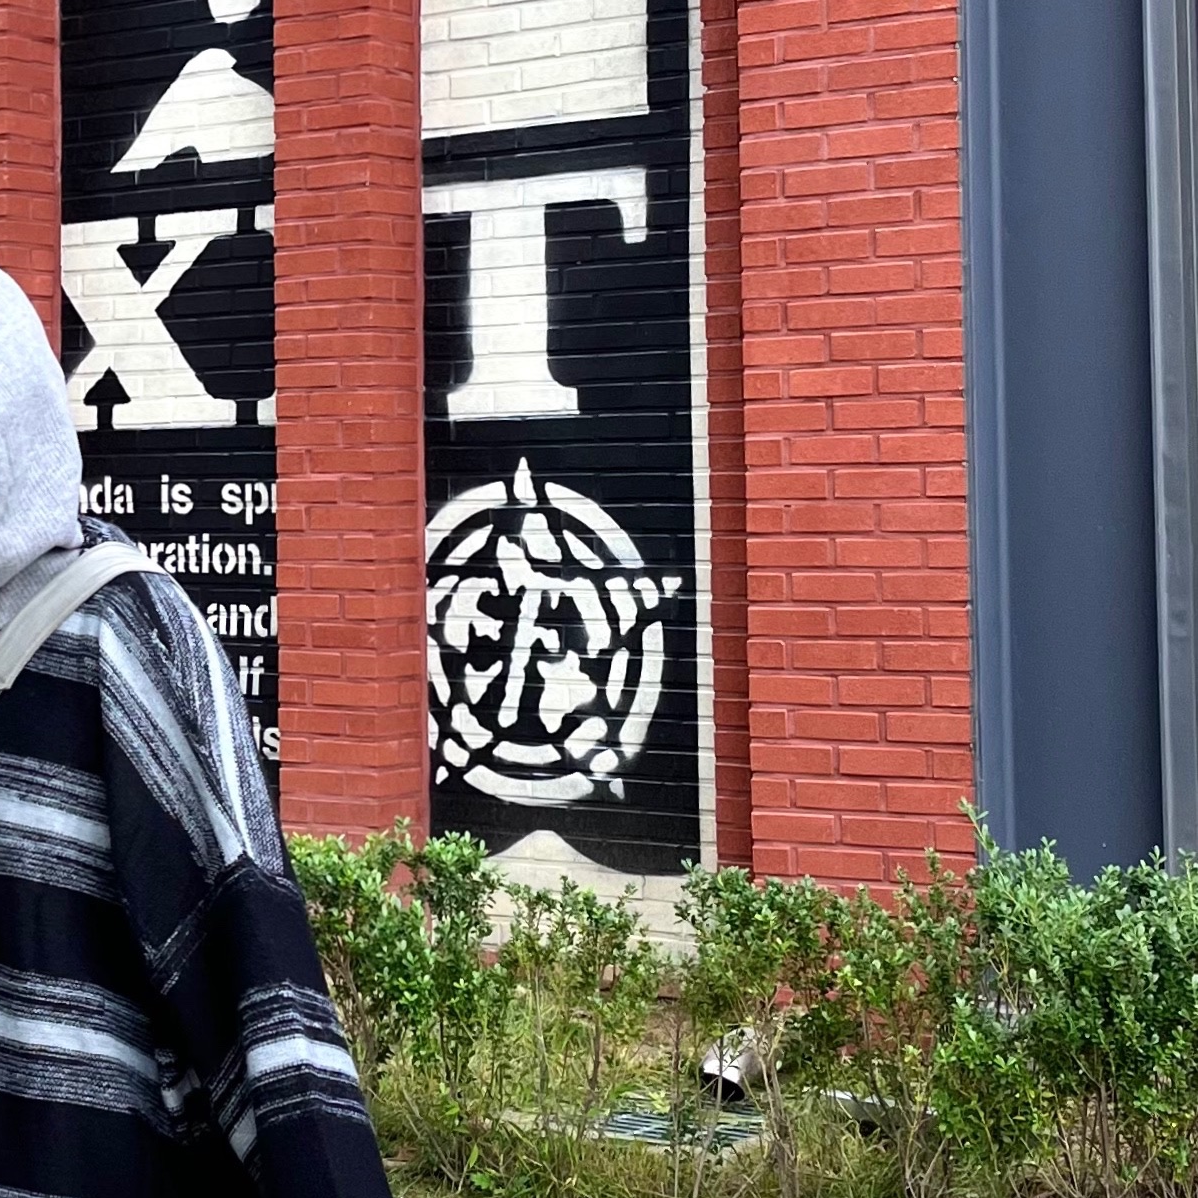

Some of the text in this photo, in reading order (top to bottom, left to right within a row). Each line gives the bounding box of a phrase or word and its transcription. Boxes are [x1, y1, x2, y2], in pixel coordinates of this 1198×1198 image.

[161, 474, 194, 515] is
[206, 595, 278, 638] and
[239, 655, 265, 696] If
